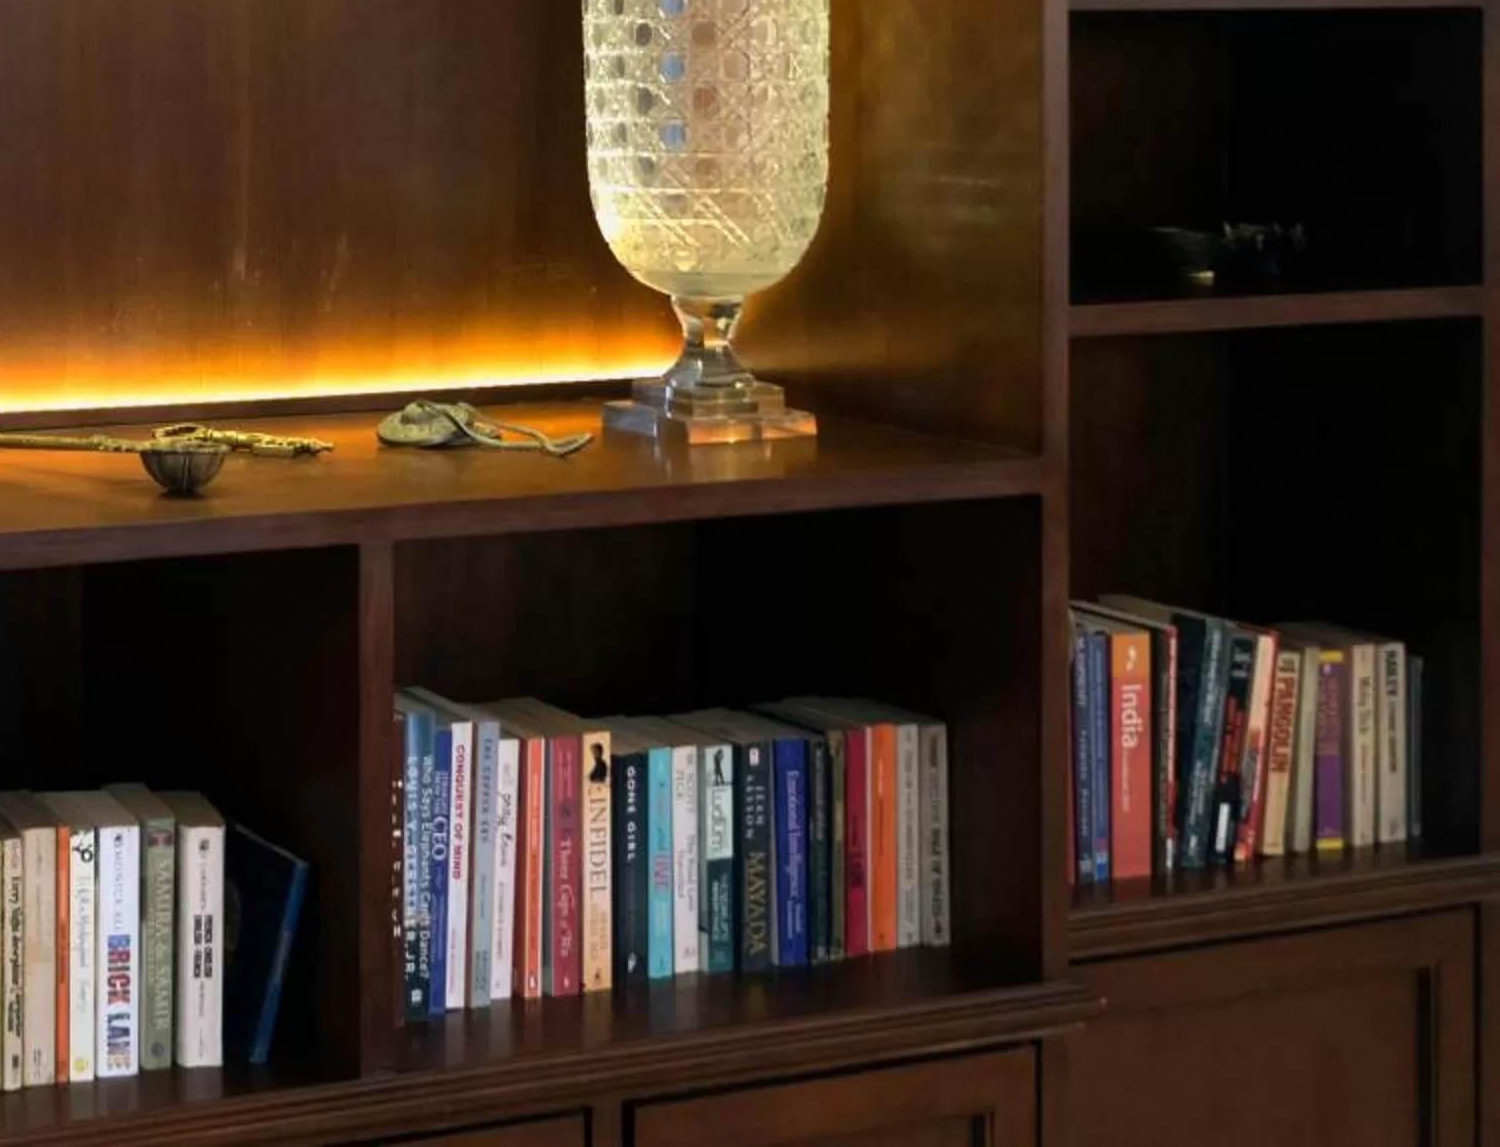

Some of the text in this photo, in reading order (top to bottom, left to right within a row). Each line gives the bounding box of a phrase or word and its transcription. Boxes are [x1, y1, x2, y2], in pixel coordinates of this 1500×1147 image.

[1121, 684, 1142, 749] India
[1271, 677, 1295, 773] PANGOLIN
[420, 789, 431, 818] Says
[422, 757, 432, 783] Who
[787, 770, 799, 829] Emotional
[432, 816, 448, 861] CEO
[452, 745, 465, 880] CONQUEST OF MIND
[627, 765, 636, 863] GONE GIRL
[418, 823, 431, 888] Elephants
[589, 797, 606, 900] INFIDEL
[155, 861, 172, 938] SAMIRA
[747, 852, 765, 955] MAYADA
[418, 930, 429, 979] Dance?
[107, 935, 131, 1070] BRICK LANE
